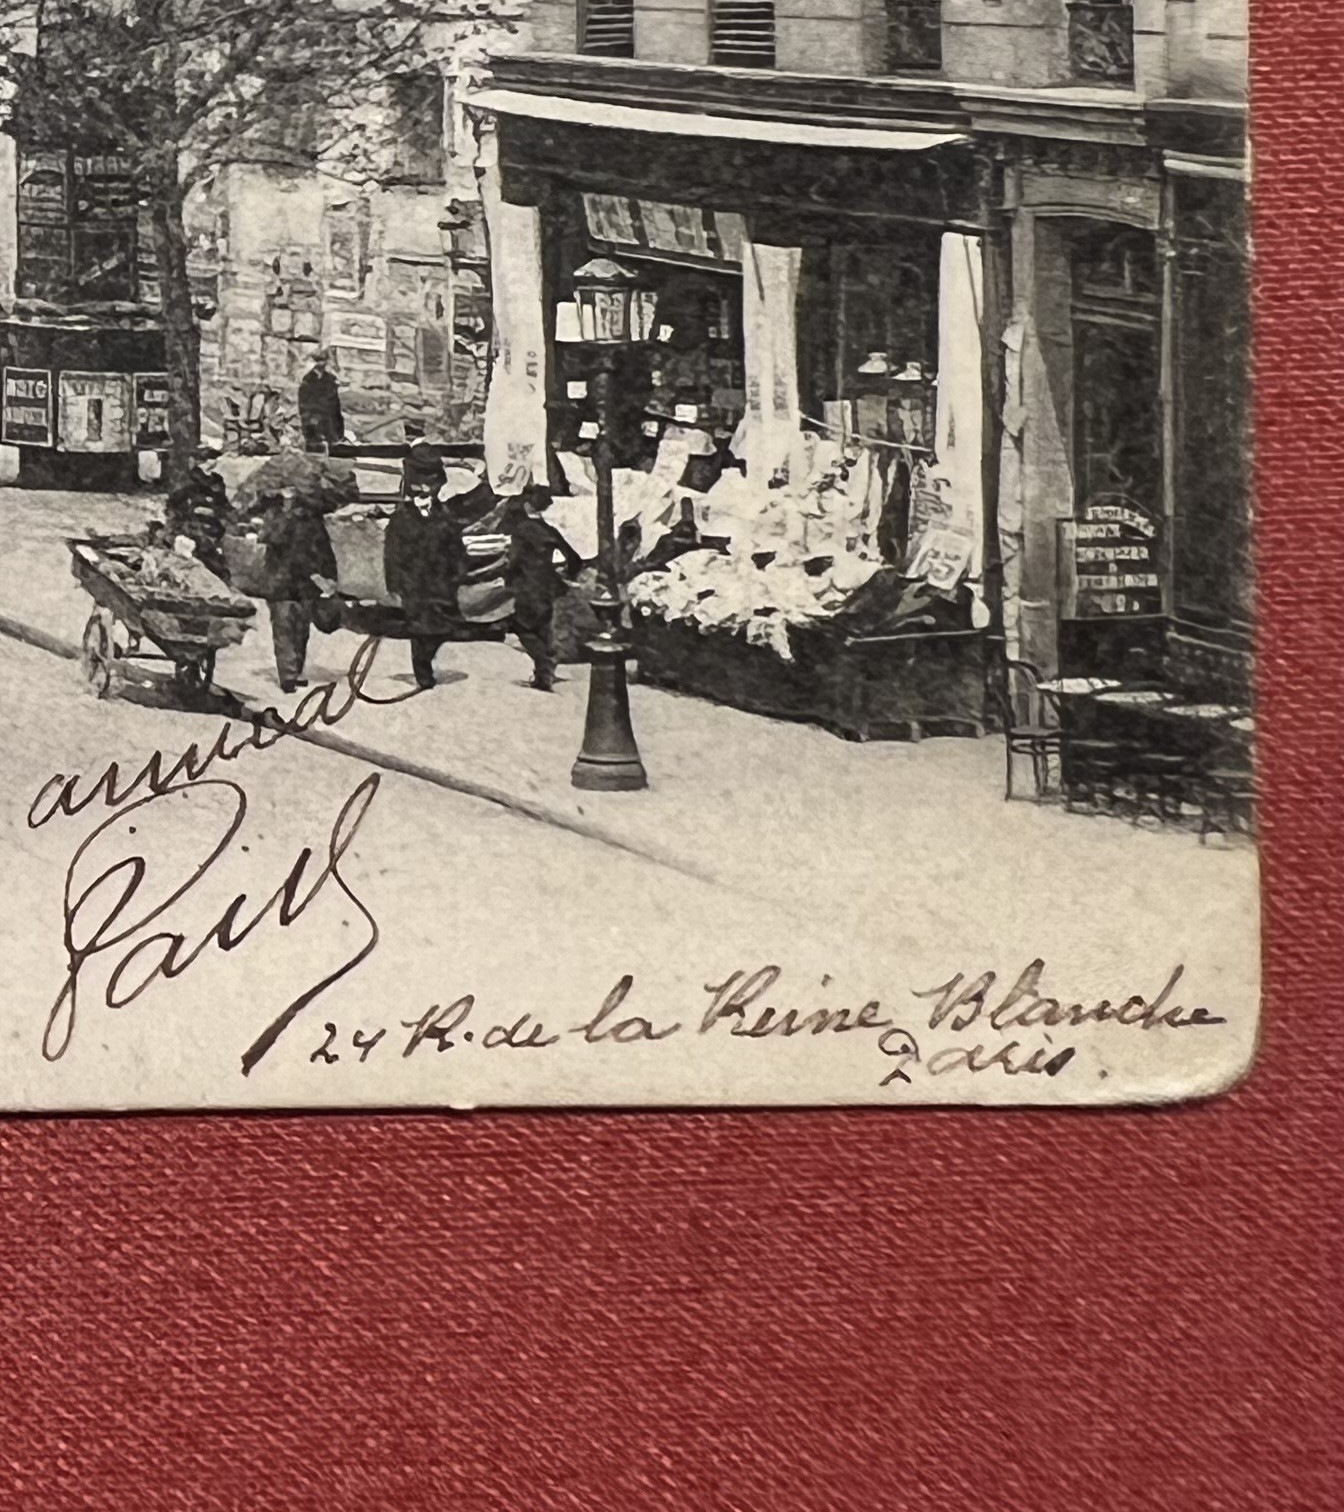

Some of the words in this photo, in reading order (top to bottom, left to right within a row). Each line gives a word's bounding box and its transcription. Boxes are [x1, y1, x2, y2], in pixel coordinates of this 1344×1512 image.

[310, 1022, 387, 1064] 24
[568, 974, 682, 1044] la
[698, 964, 894, 1039] Reine
[911, 957, 1228, 1033] Blanche
